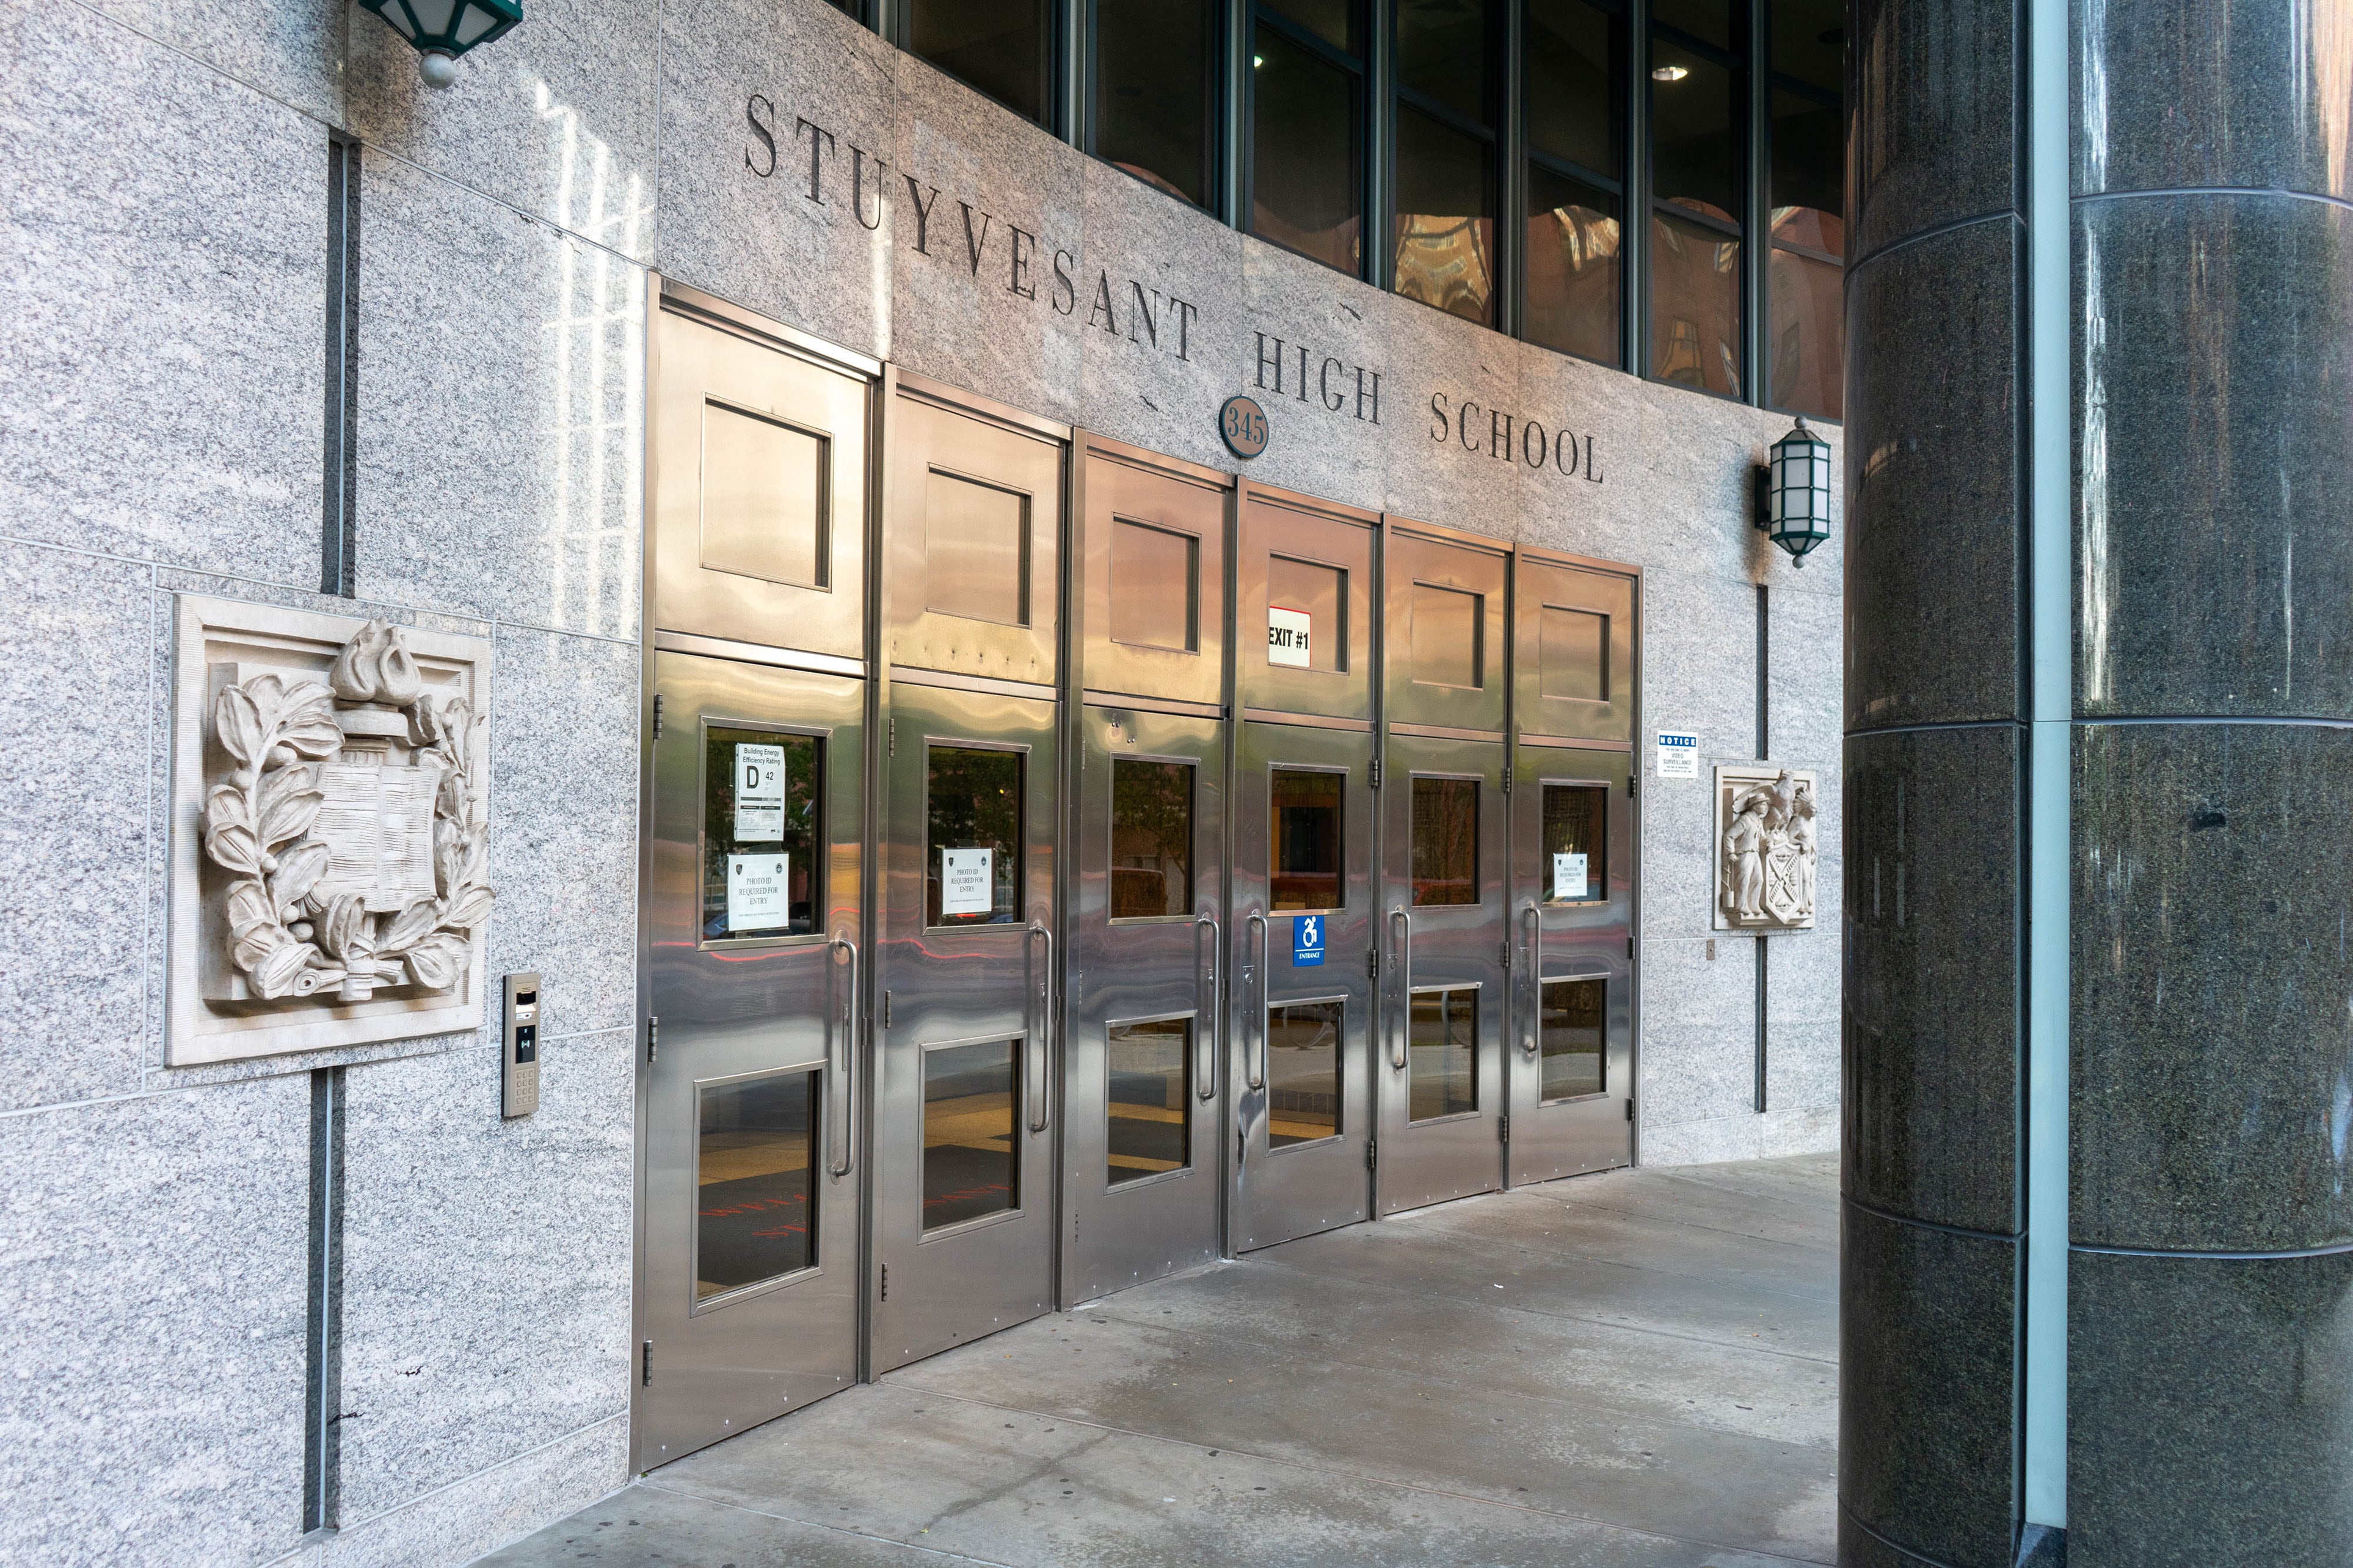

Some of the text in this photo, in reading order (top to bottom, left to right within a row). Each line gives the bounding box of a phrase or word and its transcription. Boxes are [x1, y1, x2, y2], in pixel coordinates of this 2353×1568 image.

[745, 94, 1604, 484] STUYVESANT HIGH SCHOOL
[1228, 407, 1264, 445] 345
[1269, 626, 1308, 650] EXIT #1
[1660, 736, 1695, 746] NOTICE
[744, 748, 779, 757] Building Energy
[743, 756, 781, 766] Efficiency Rating
[746, 765, 759, 789] D
[765, 772, 774, 780] 42
[746, 877, 765, 885] PHOTO
[739, 887, 767, 896] REQUIRED
[749, 897, 768, 905] ENTRY
